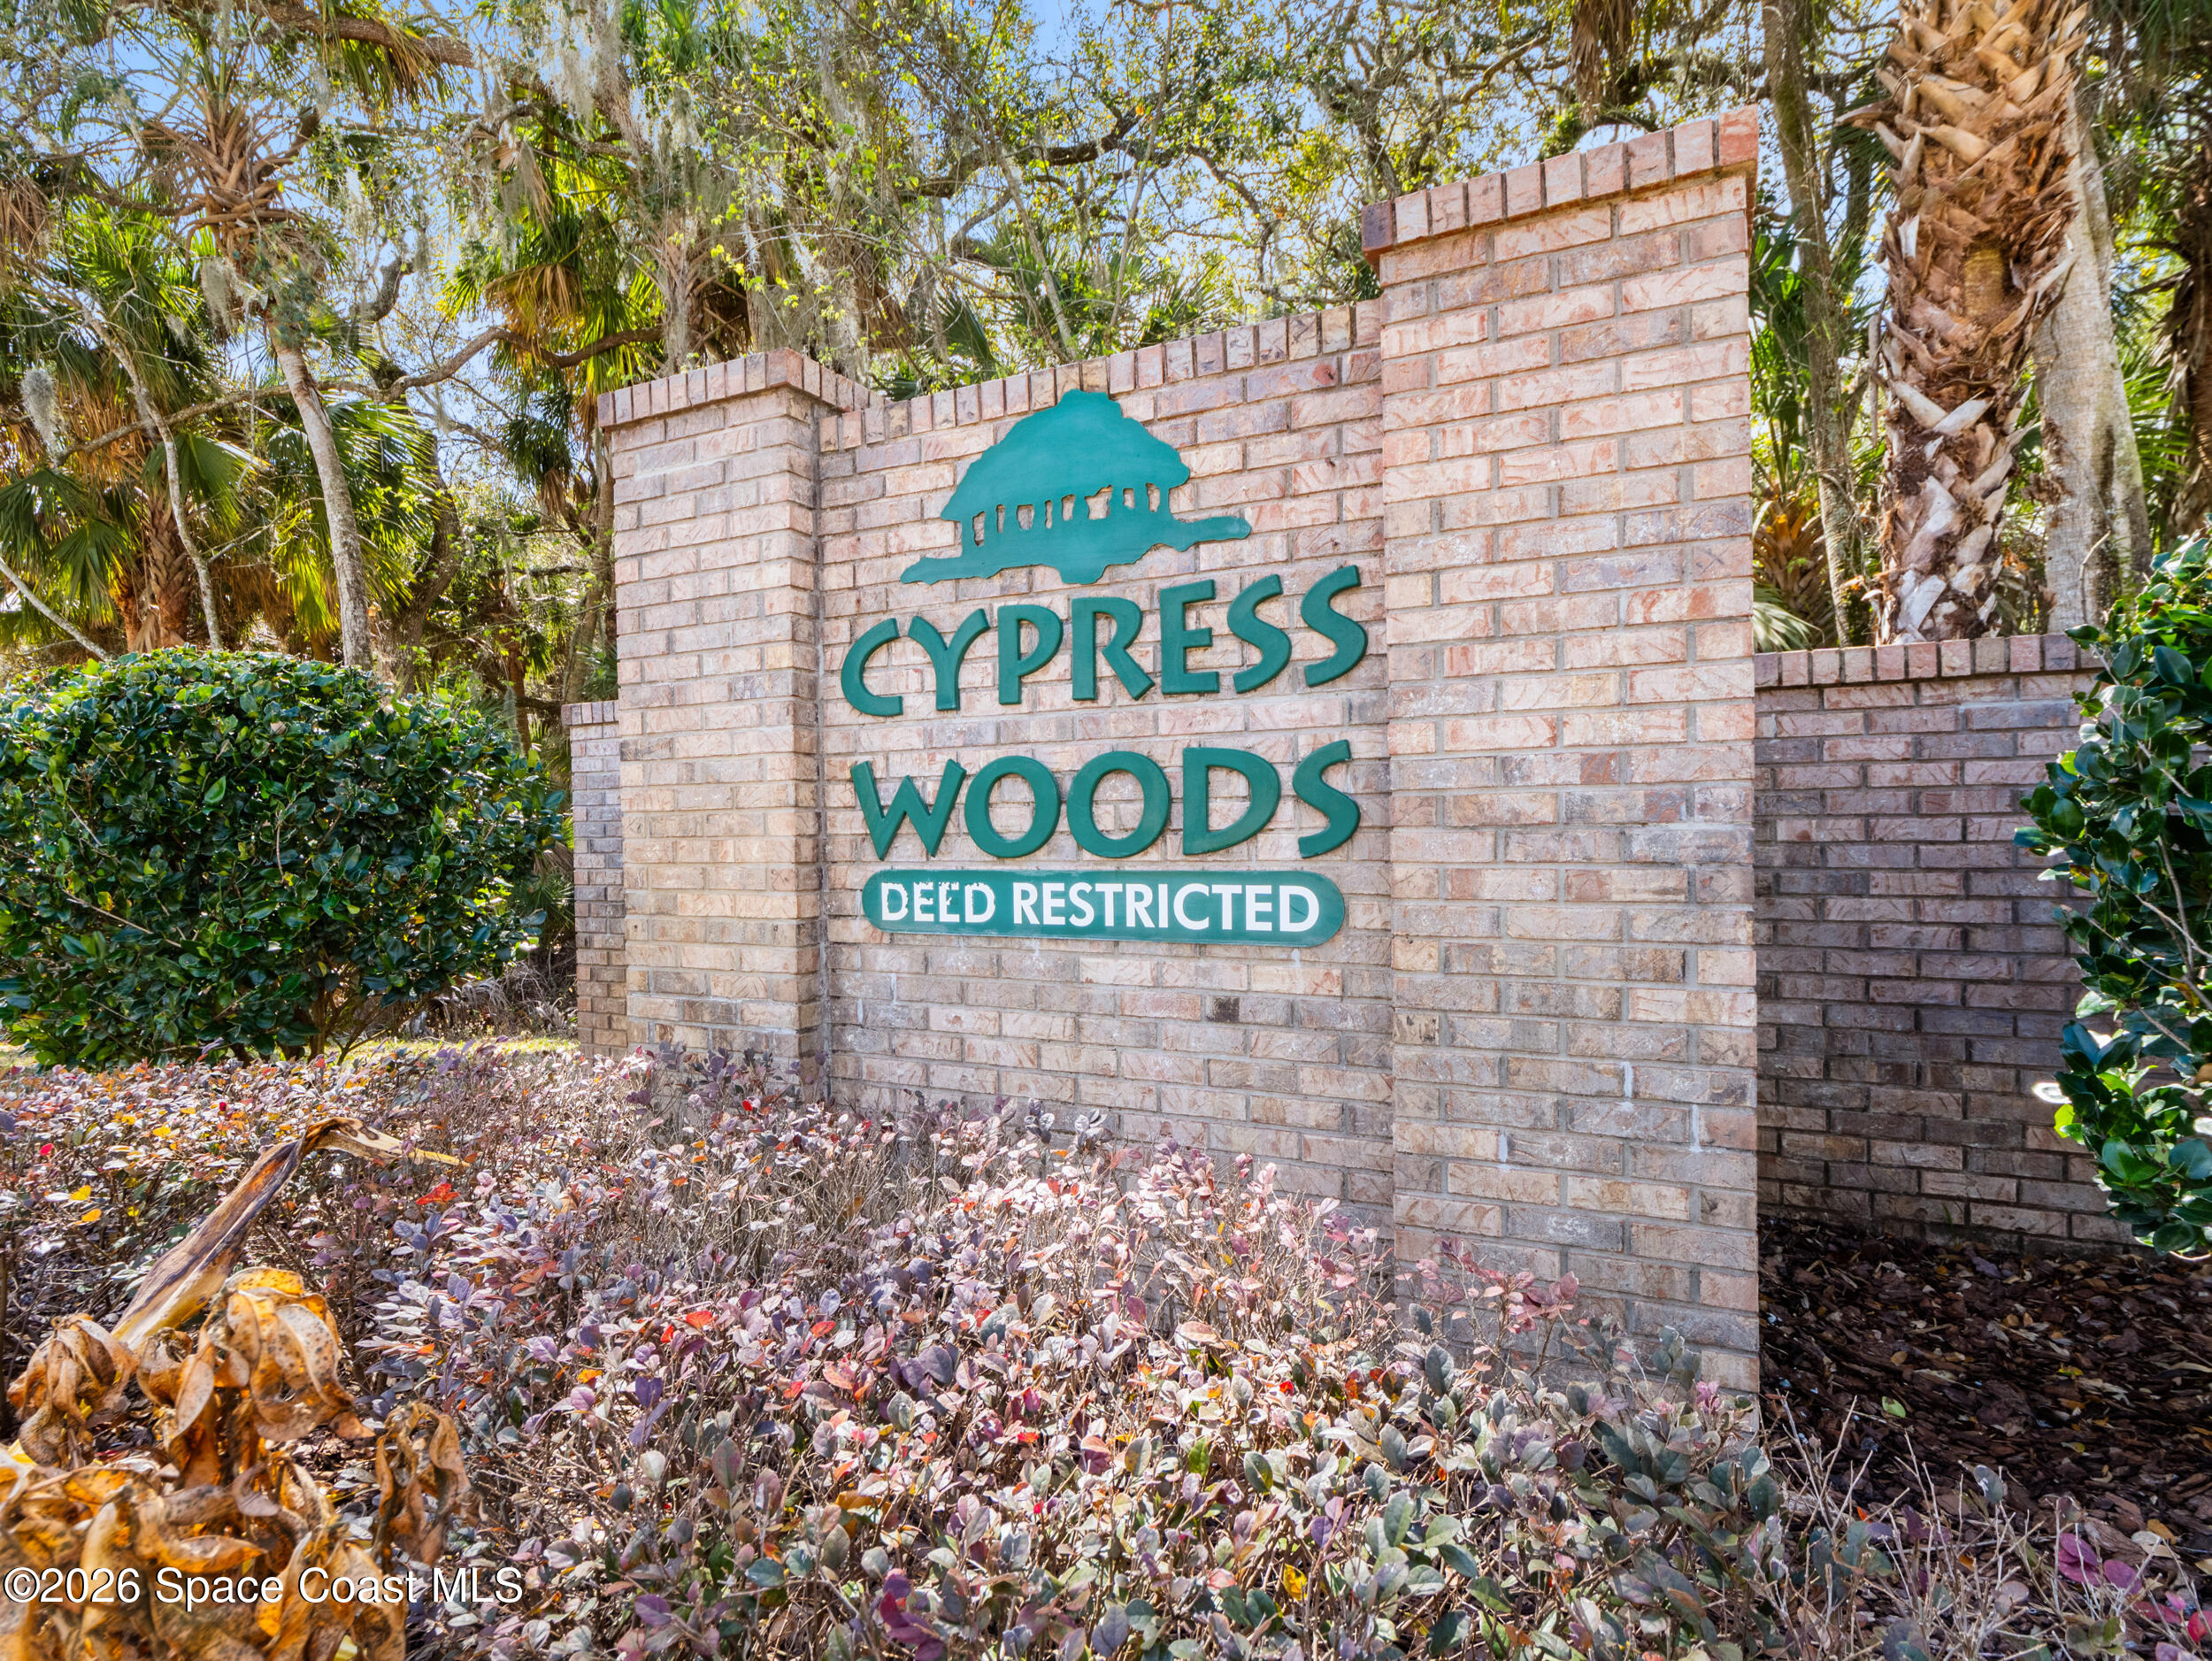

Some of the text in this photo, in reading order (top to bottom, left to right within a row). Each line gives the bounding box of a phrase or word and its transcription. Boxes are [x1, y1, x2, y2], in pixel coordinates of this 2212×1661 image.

[841, 565, 1368, 717] CYPRESS
[850, 739, 1361, 861] WOODS
[880, 881, 1320, 932] DEED RESTRICTED
